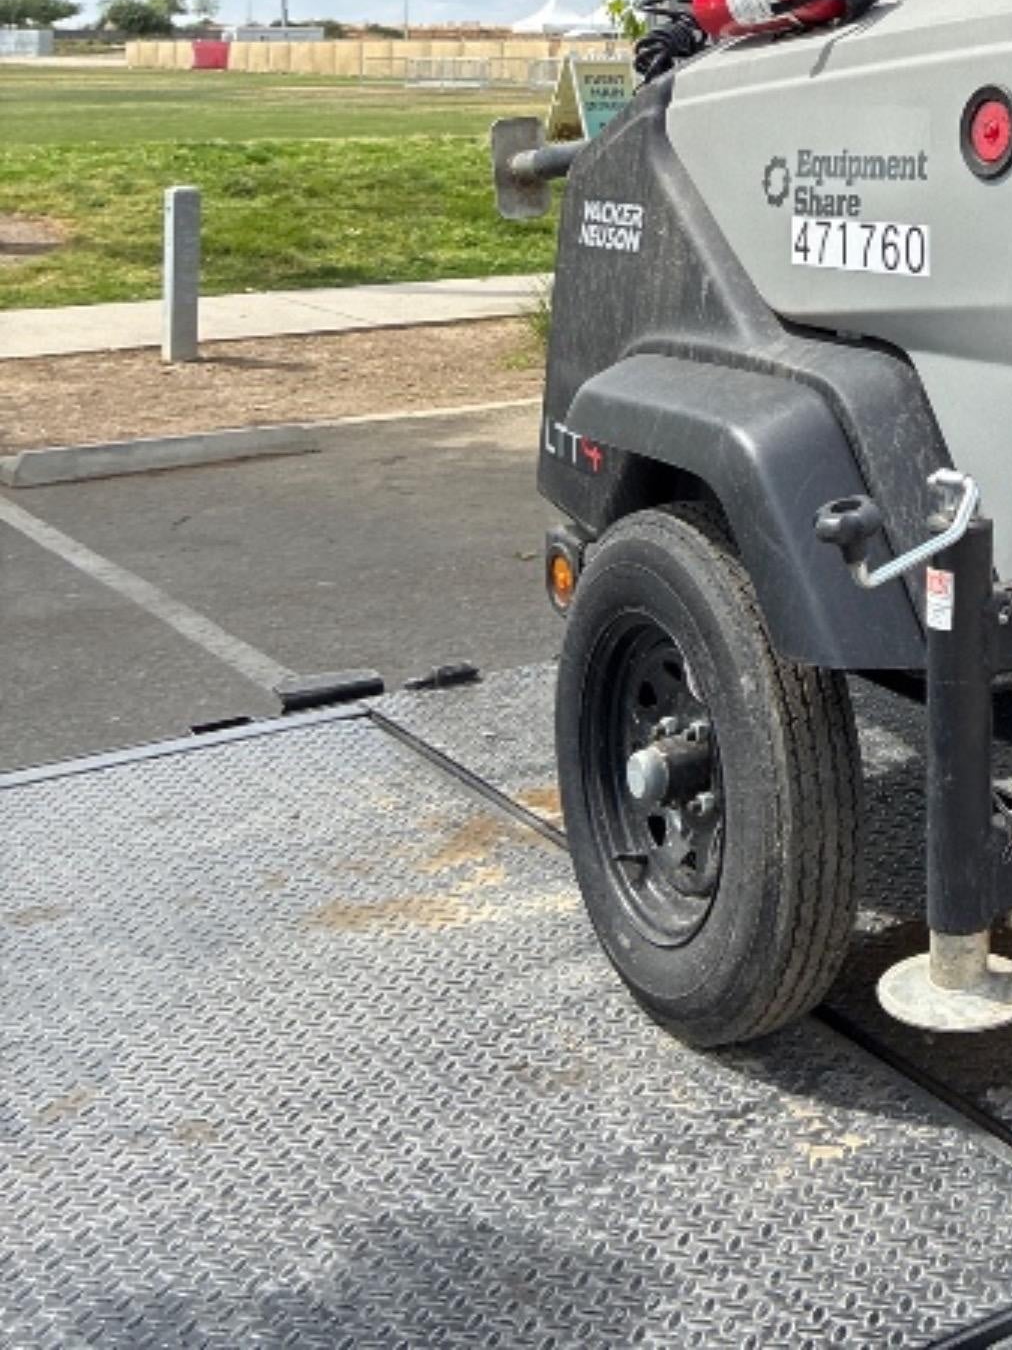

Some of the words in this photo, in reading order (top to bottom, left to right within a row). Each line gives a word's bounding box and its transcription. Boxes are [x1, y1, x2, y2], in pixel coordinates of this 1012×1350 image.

[795, 149, 928, 187] Equipment
[793, 185, 862, 217] Share
[794, 221, 926, 274] 471760
